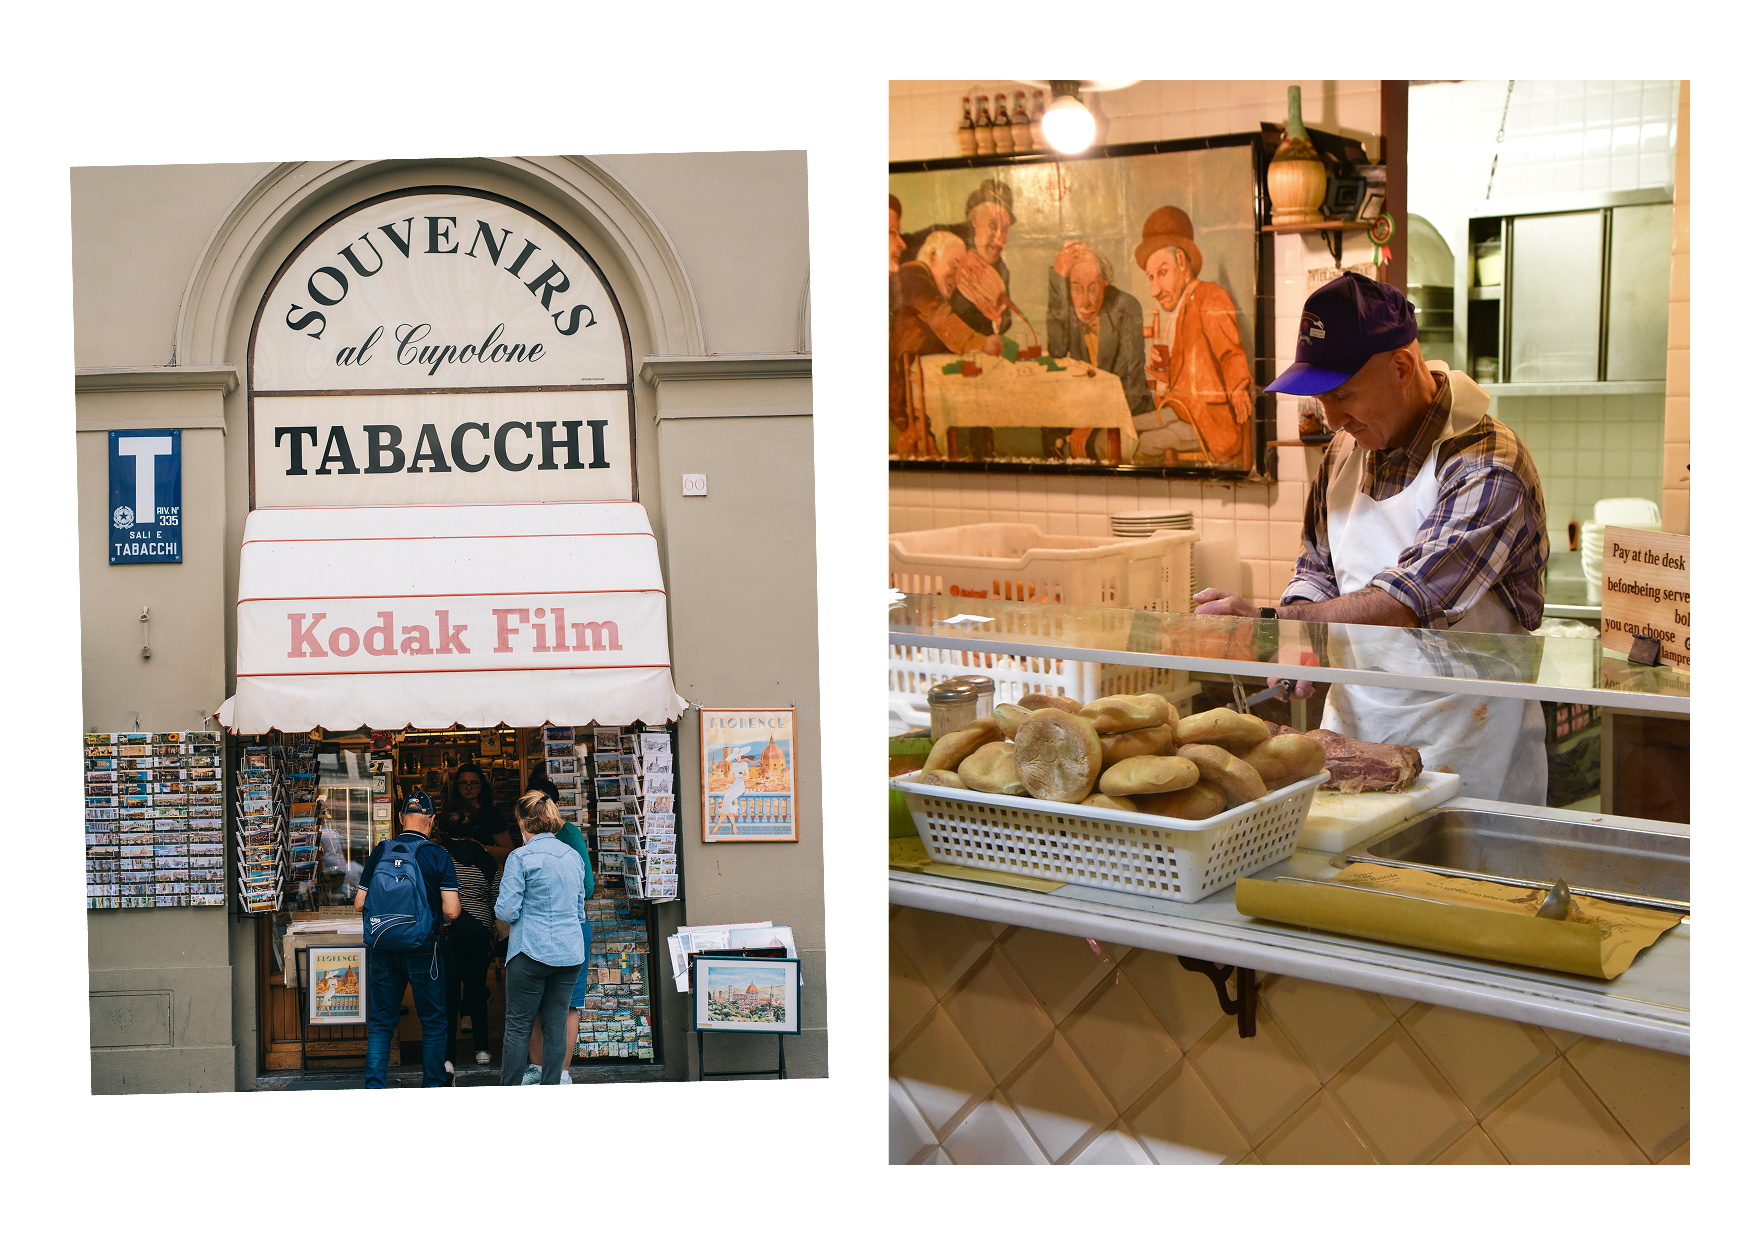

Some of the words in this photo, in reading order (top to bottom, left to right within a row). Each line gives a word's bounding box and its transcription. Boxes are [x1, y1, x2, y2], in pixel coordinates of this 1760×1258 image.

[286, 215, 598, 341] SOUVENIRS
[336, 325, 384, 367] al
[395, 323, 547, 376] Cupolone
[274, 419, 611, 476] TABACCHI
[118, 436, 172, 523] T
[684, 475, 705, 491] 60
[156, 507, 170, 515] RIV.
[159, 515, 179, 526] 335
[129, 531, 151, 539] SALI
[156, 531, 162, 539] E
[115, 542, 177, 556] TABACCHI
[1612, 543, 1630, 564] Pay
[1632, 549, 1642, 562] at
[1644, 549, 1660, 566] the
[1662, 552, 1686, 571] desk
[1663, 589, 1690, 604] serve
[286, 609, 470, 659] Kodak
[492, 607, 623, 655] Film
[1605, 618, 1622, 632] you
[1624, 622, 1640, 635] can
[1642, 623, 1676, 643] choose
[1661, 646, 1690, 666] lampre
[710, 717, 785, 728] FLORENCE
